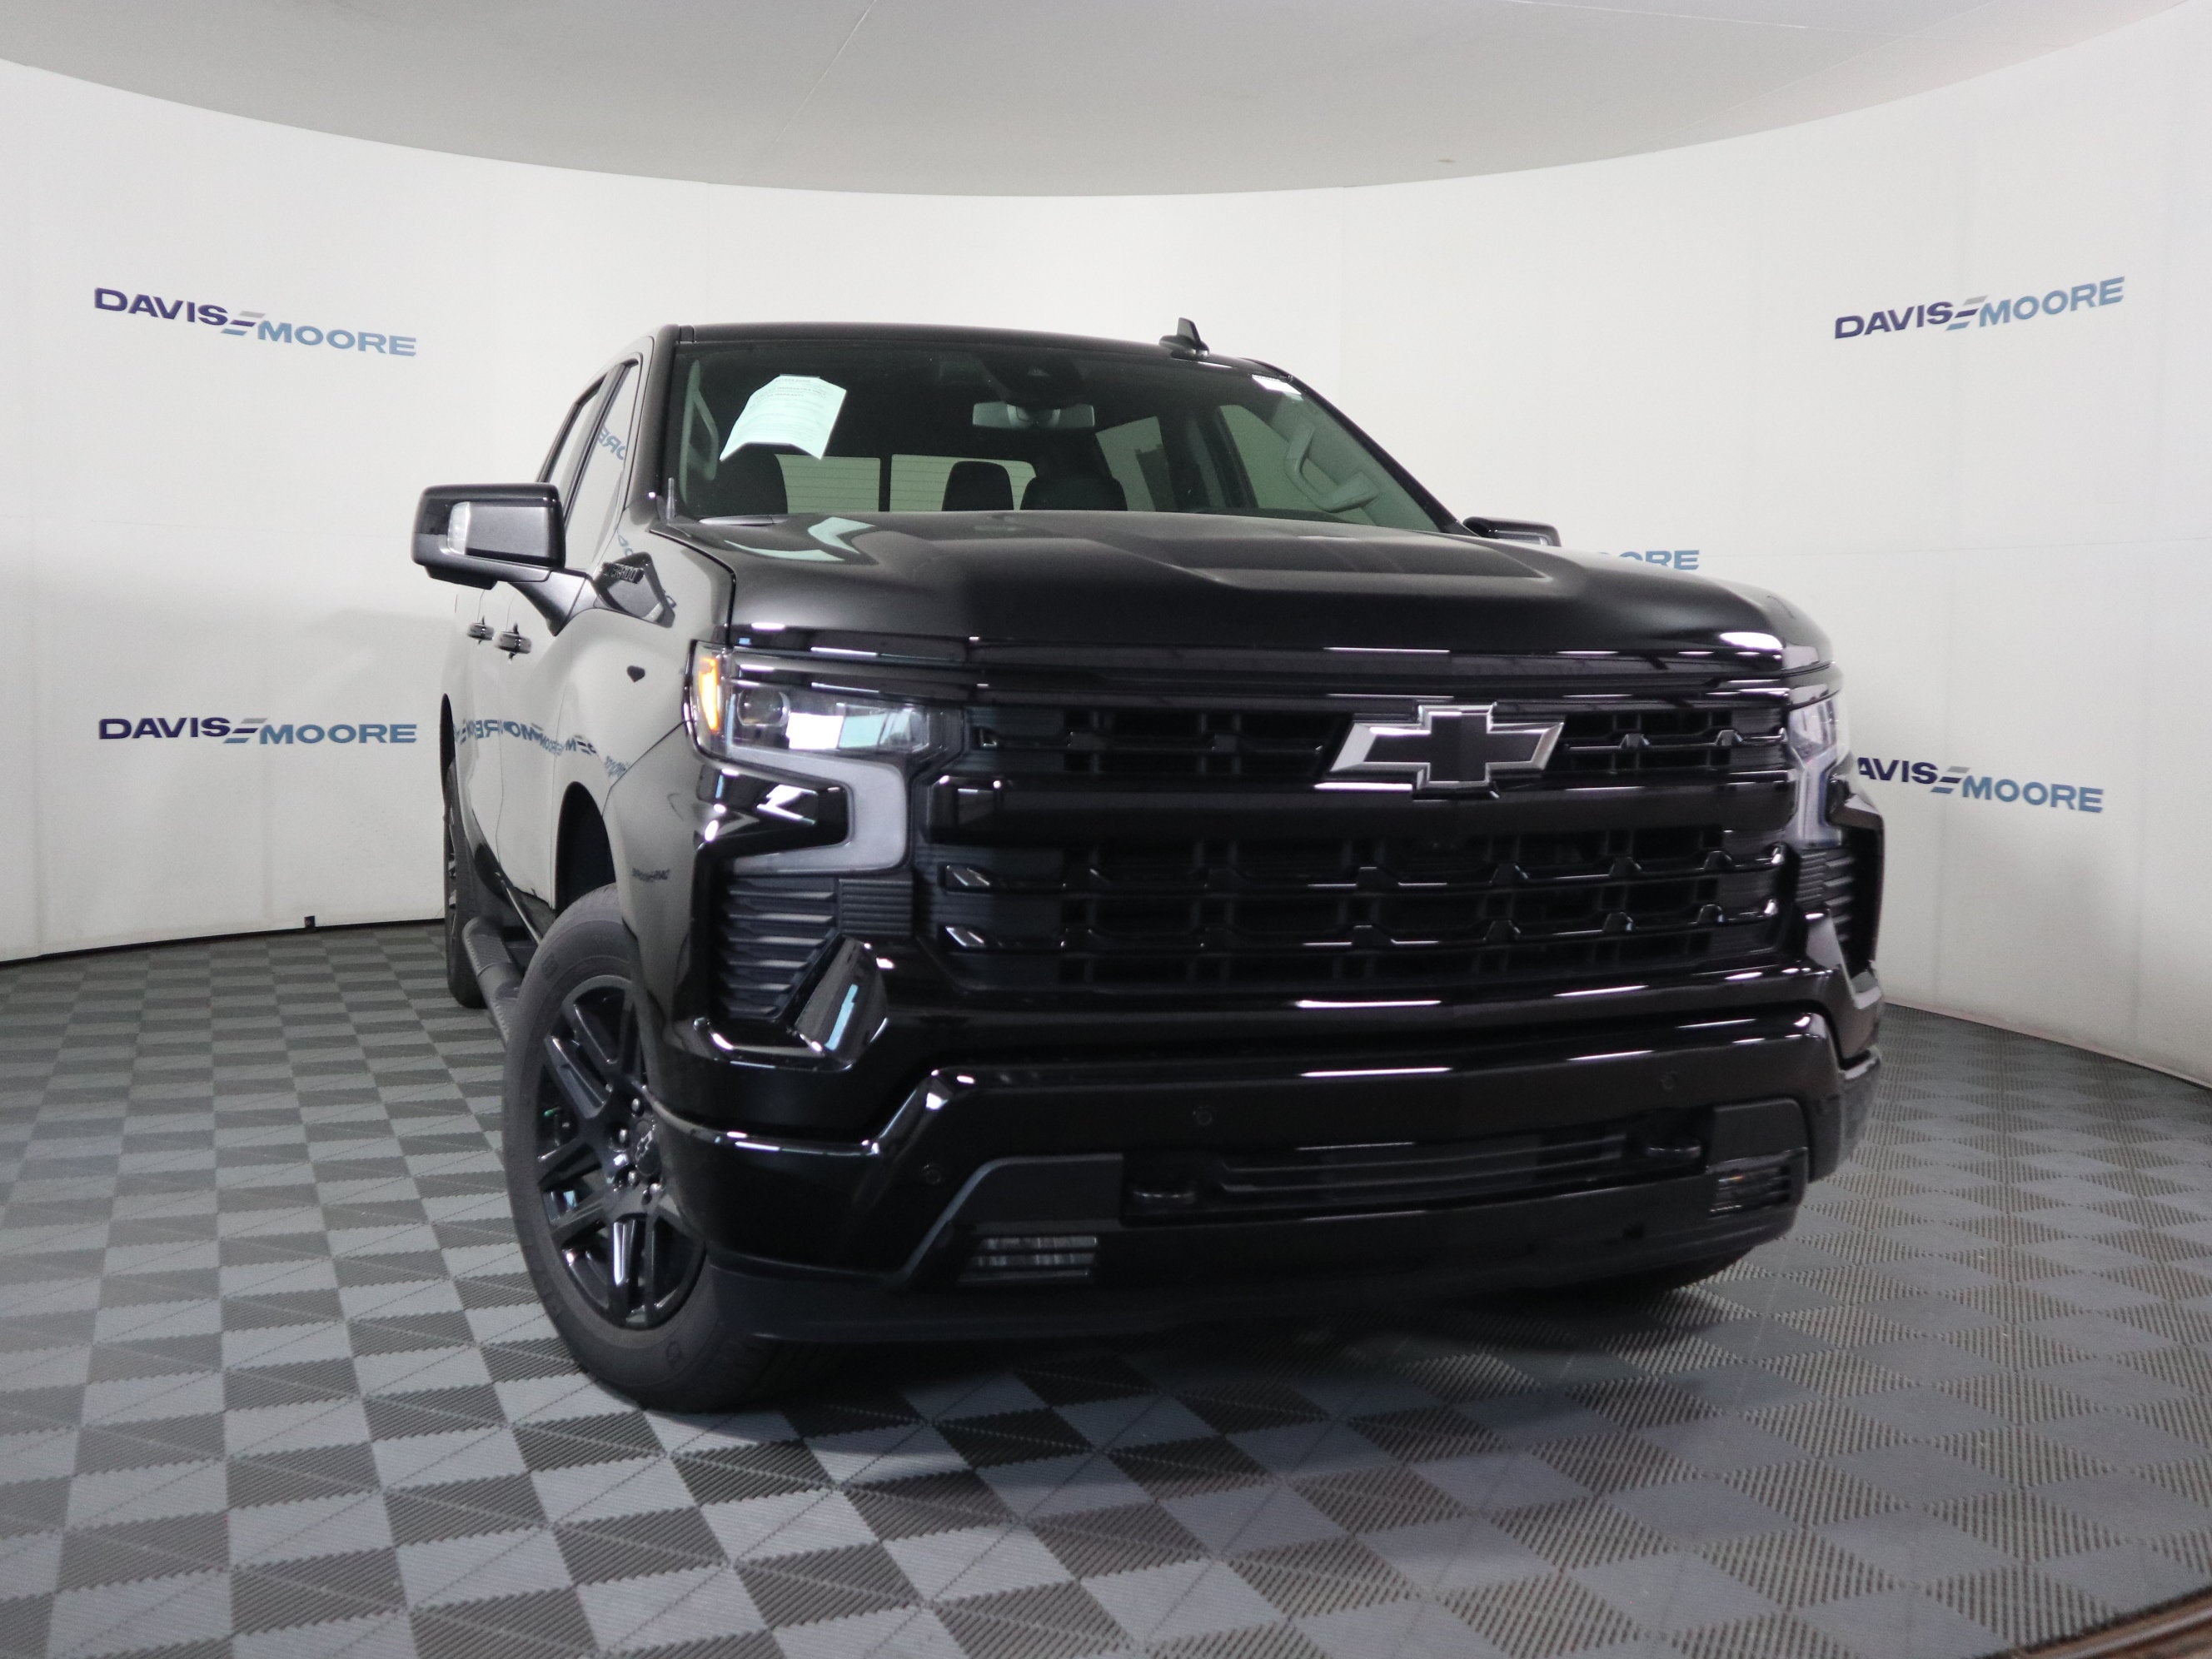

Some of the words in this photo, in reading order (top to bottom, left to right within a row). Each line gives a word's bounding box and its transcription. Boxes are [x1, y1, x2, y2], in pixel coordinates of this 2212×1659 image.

[94, 287, 228, 326] DAVIS
[257, 320, 417, 357] MOORE
[1835, 301, 1954, 340] DAVIS
[1979, 276, 2125, 328] MOORE
[98, 717, 232, 740] DAVIS
[259, 724, 417, 745] MOORE
[1857, 757, 1938, 785] AVIS
[1961, 775, 2104, 813] MOORE
